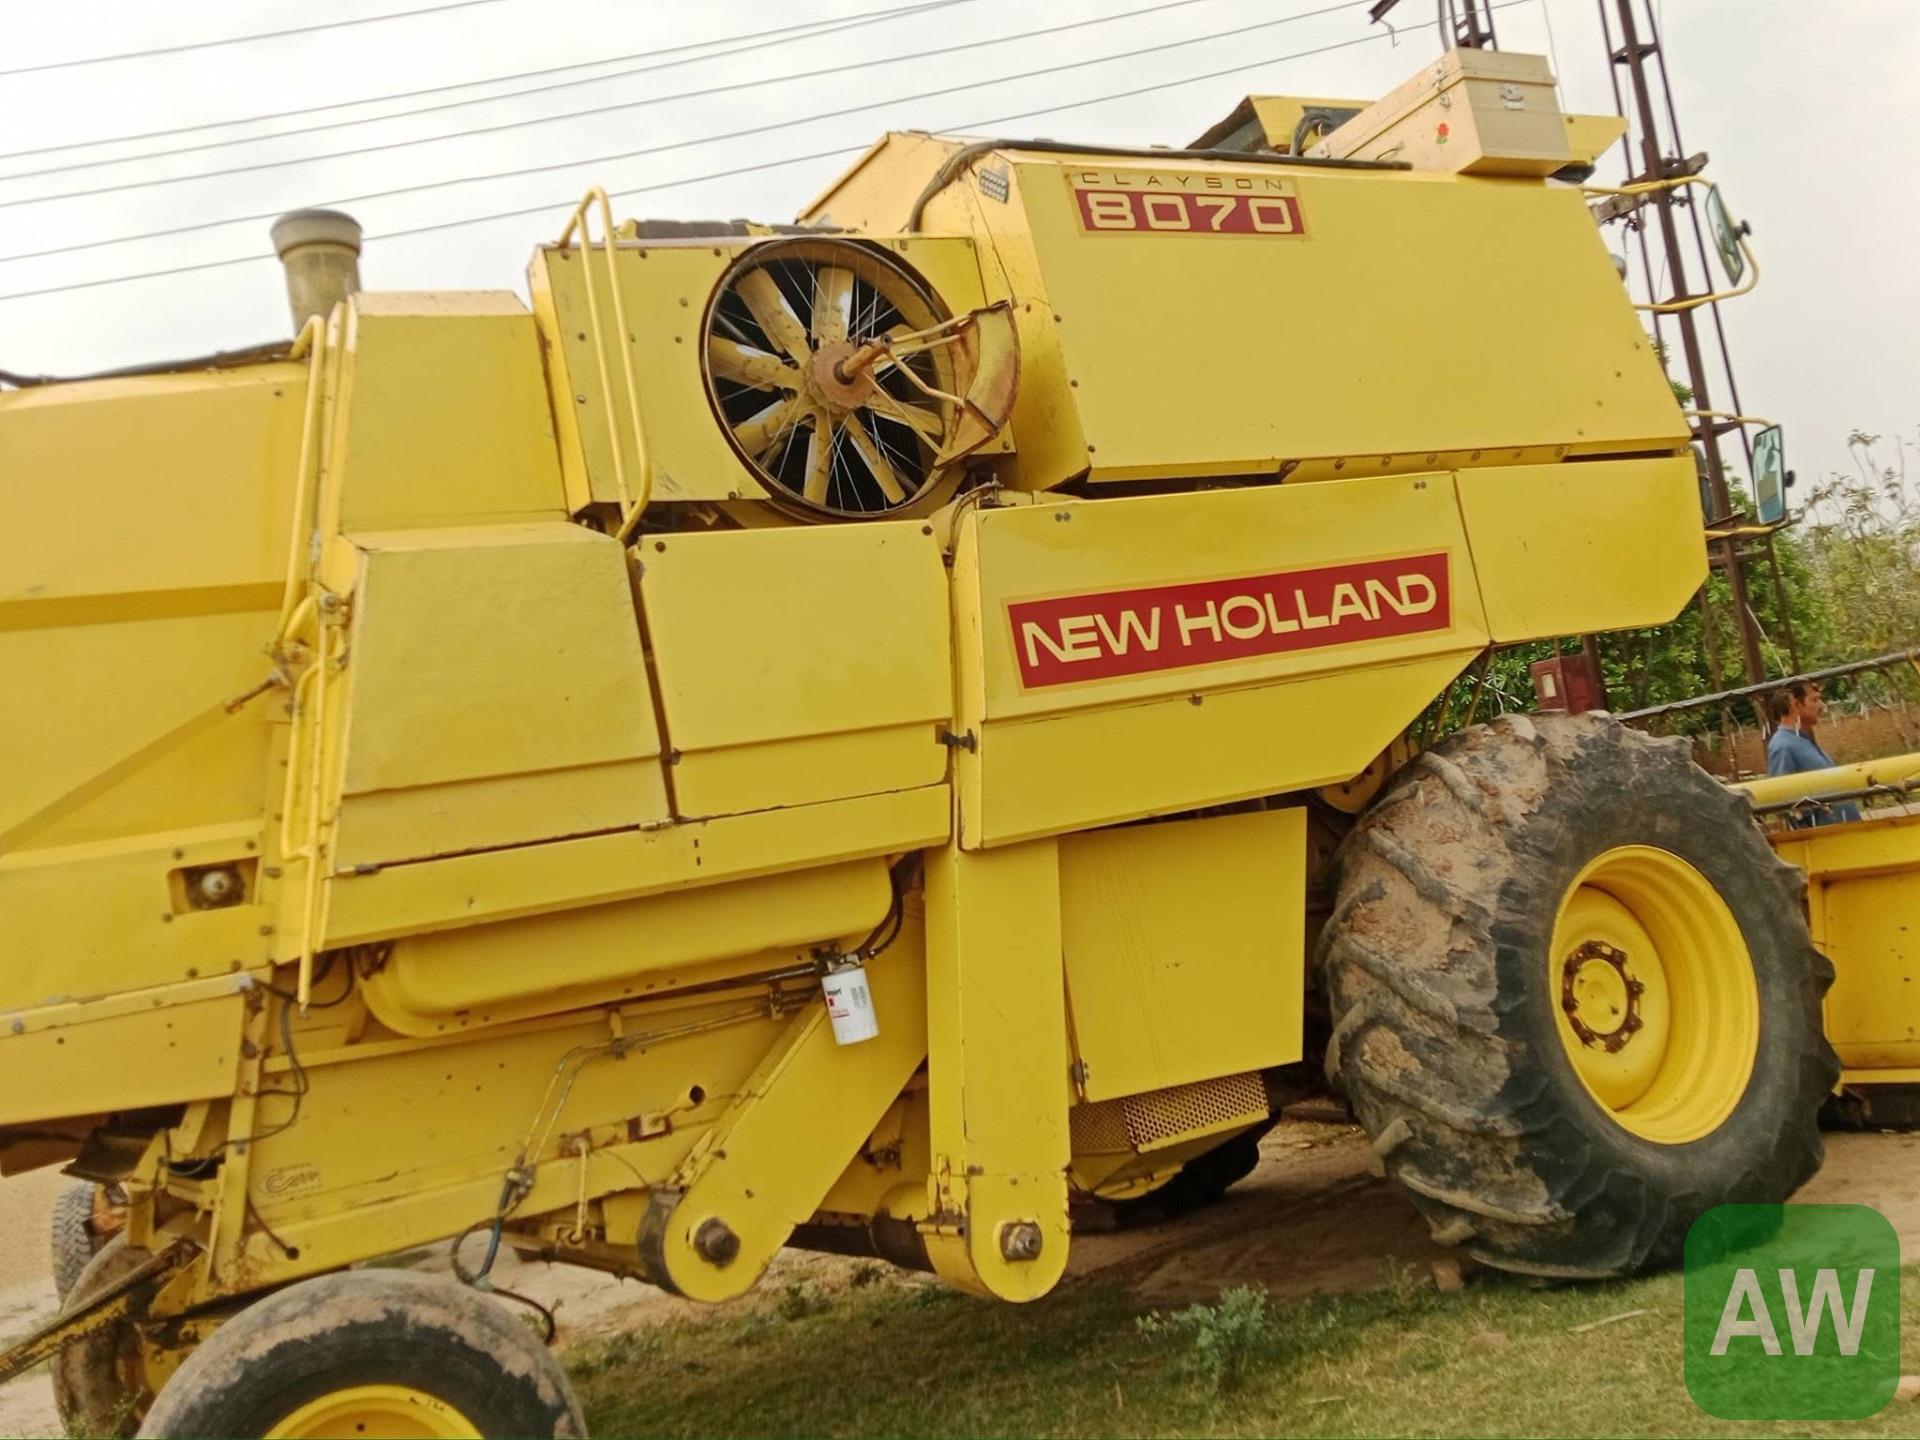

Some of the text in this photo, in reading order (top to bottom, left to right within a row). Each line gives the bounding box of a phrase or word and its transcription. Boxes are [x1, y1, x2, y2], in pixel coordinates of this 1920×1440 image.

[1081, 172, 1282, 190] CLAYSON
[1086, 191, 1293, 233] 8070
[1021, 573, 1437, 667] NEW HOLLAND
